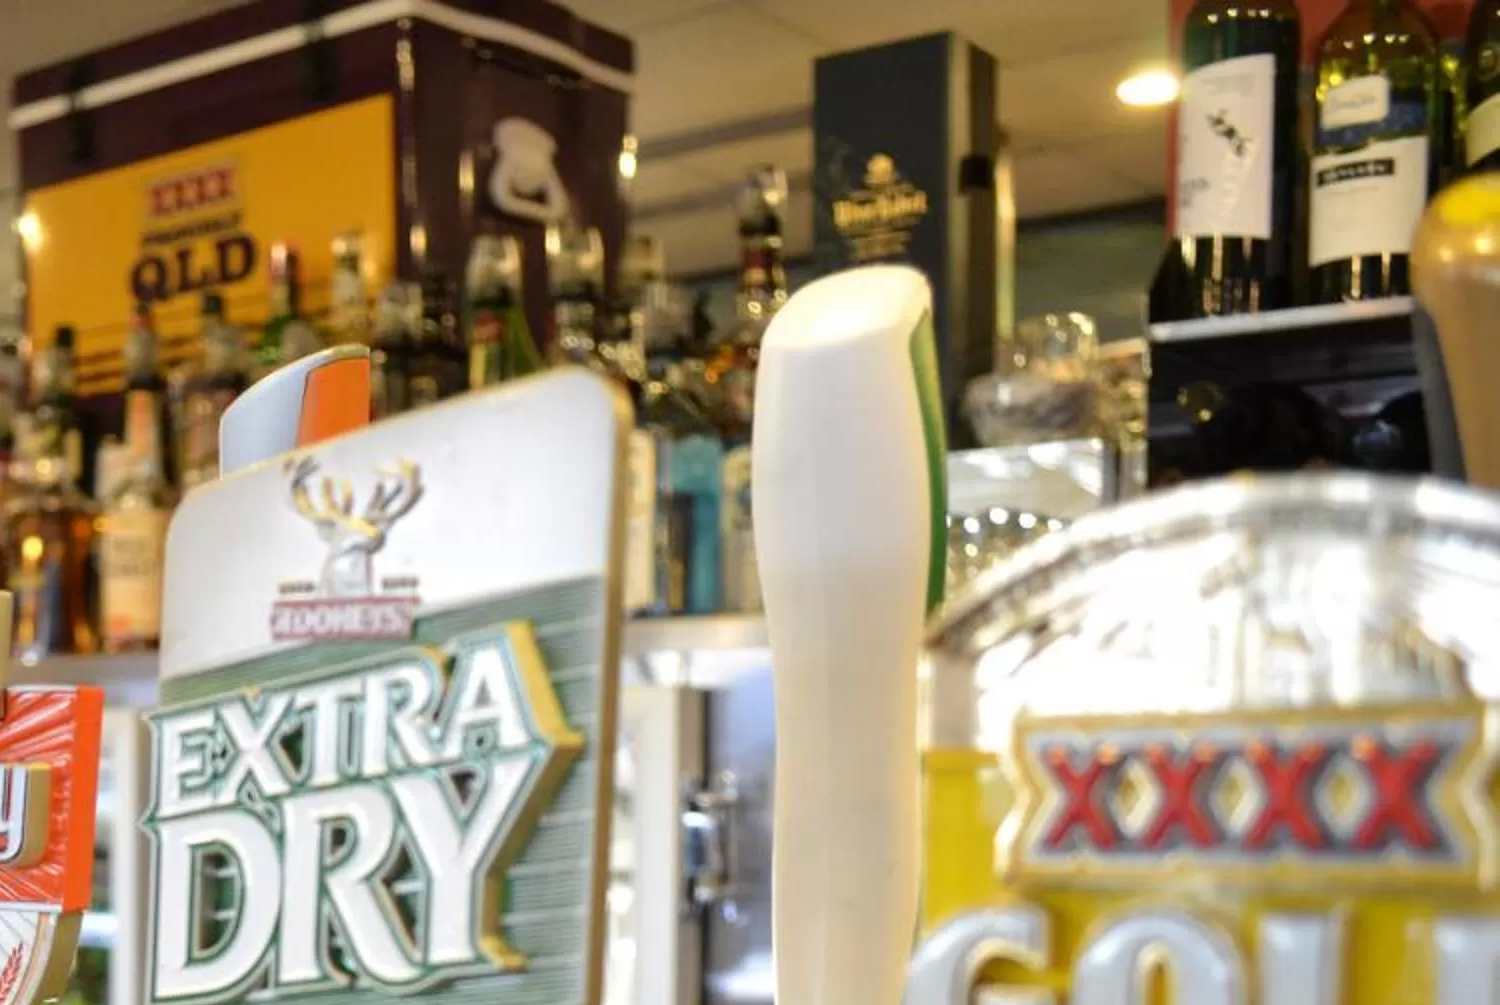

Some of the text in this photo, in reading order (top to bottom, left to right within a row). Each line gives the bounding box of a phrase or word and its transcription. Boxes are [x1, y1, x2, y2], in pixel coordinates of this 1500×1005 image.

[131, 236, 257, 302] QLD
[152, 628, 548, 824] EXTRA
[1041, 735, 1439, 852] XXXX
